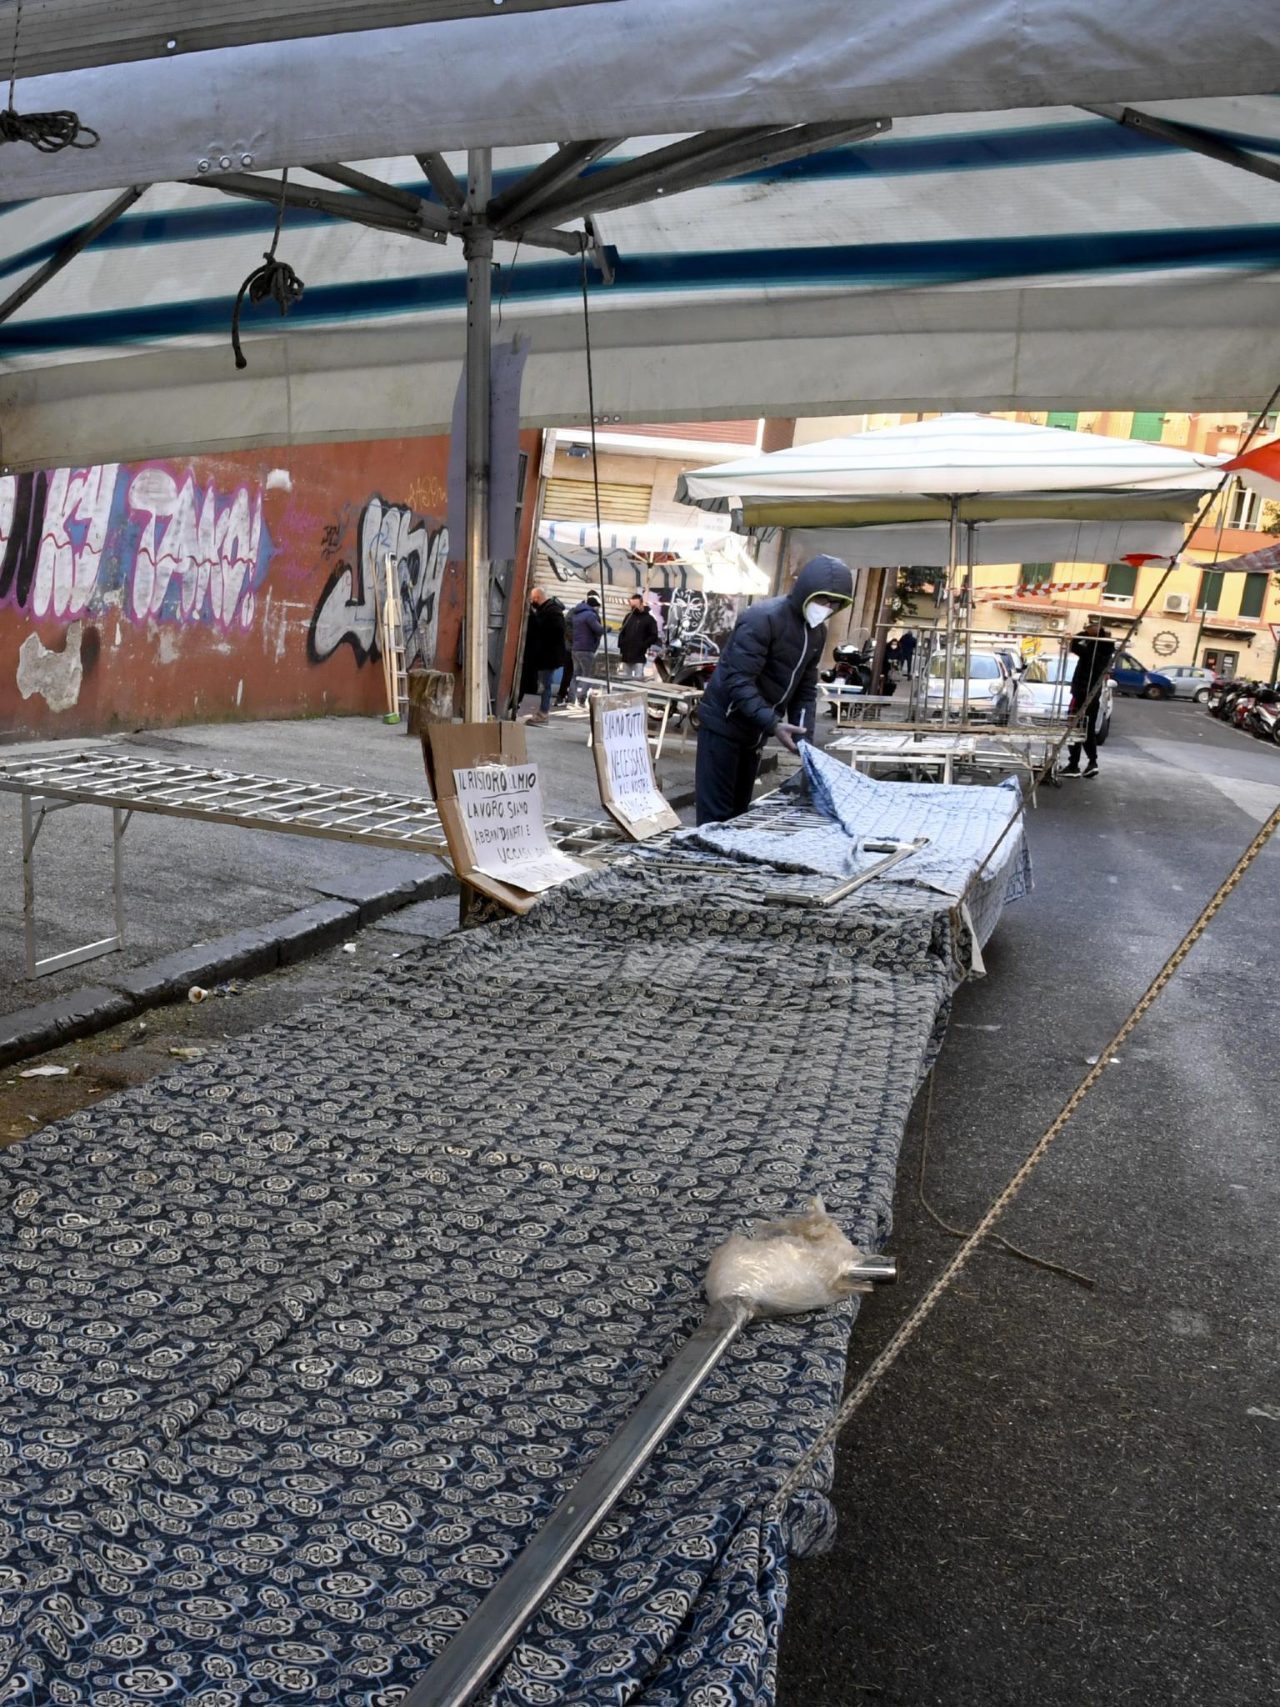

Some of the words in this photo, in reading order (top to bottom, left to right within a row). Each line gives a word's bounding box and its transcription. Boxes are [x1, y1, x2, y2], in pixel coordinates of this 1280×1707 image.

[467, 771, 507, 792] RISTORO
[517, 773, 536, 789] MIO
[467, 800, 504, 818] LAVORO
